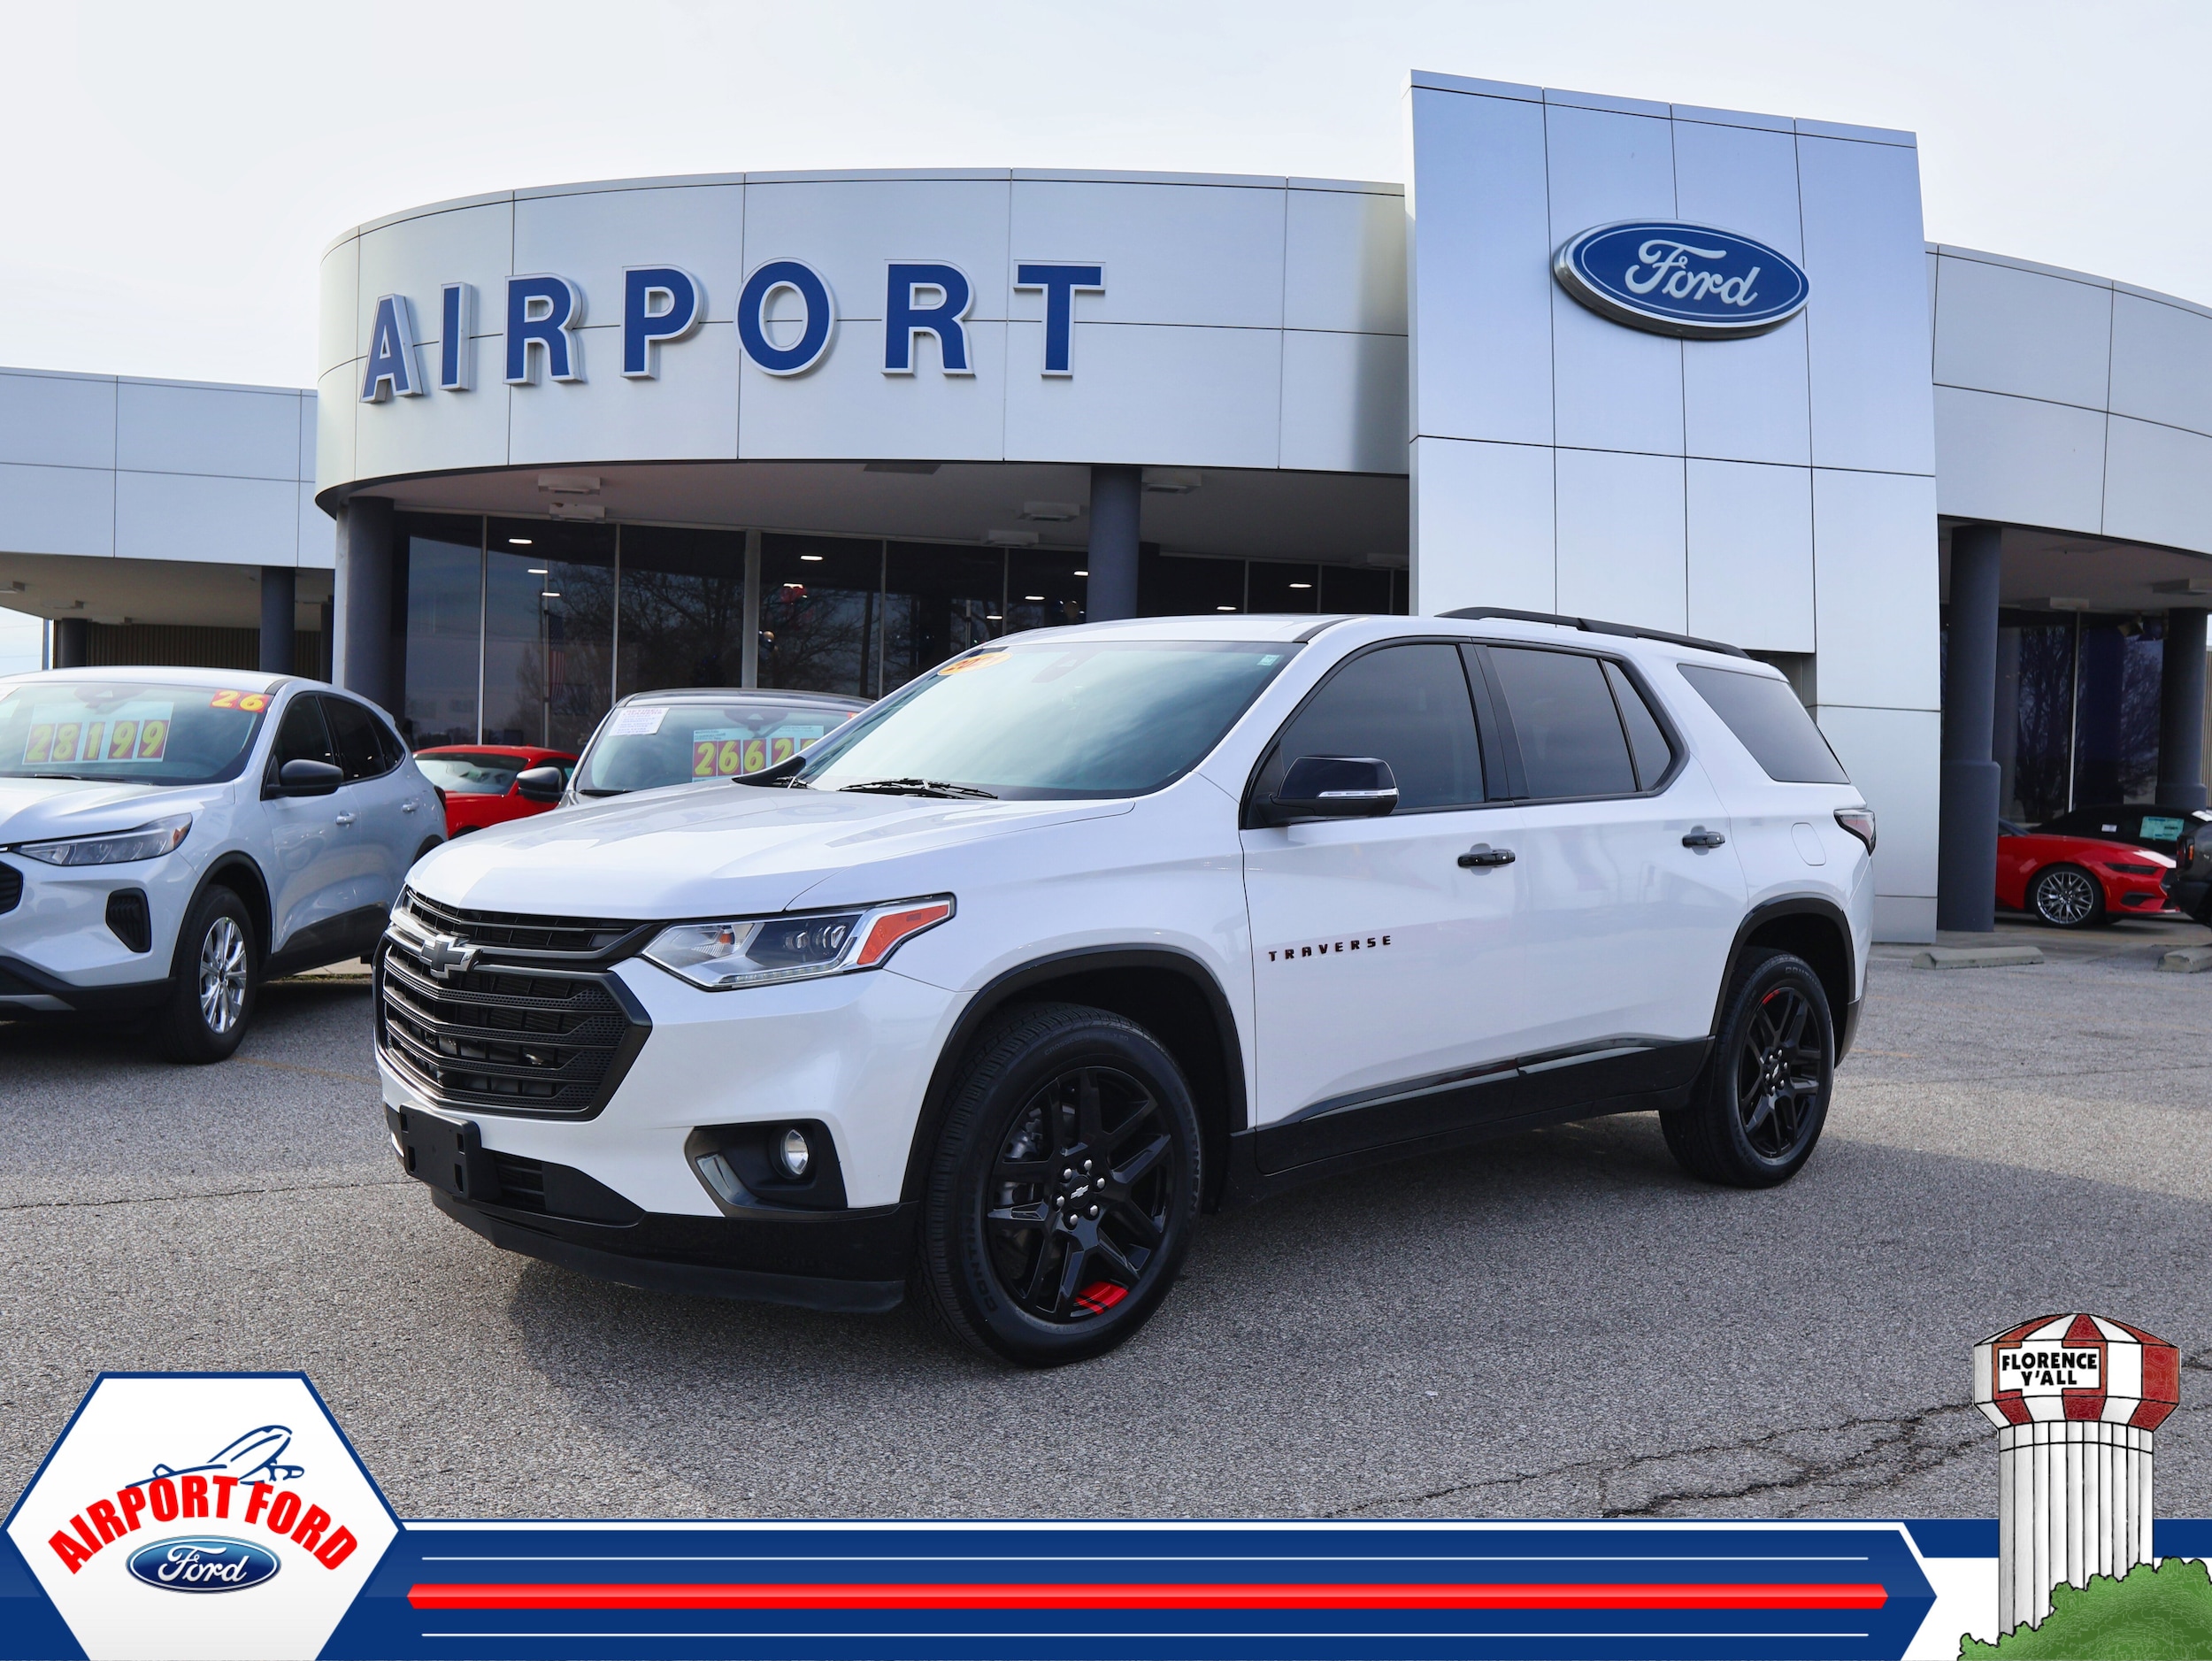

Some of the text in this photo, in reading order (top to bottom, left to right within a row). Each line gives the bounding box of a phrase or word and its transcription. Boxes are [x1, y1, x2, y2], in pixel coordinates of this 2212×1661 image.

[1624, 239, 1761, 306] Ford
[358, 257, 1106, 404] AIRPORT
[212, 690, 265, 711] 26
[26, 720, 166, 761] 28199
[695, 738, 818, 776] 2662
[1268, 935, 1391, 962] TRAVERSE
